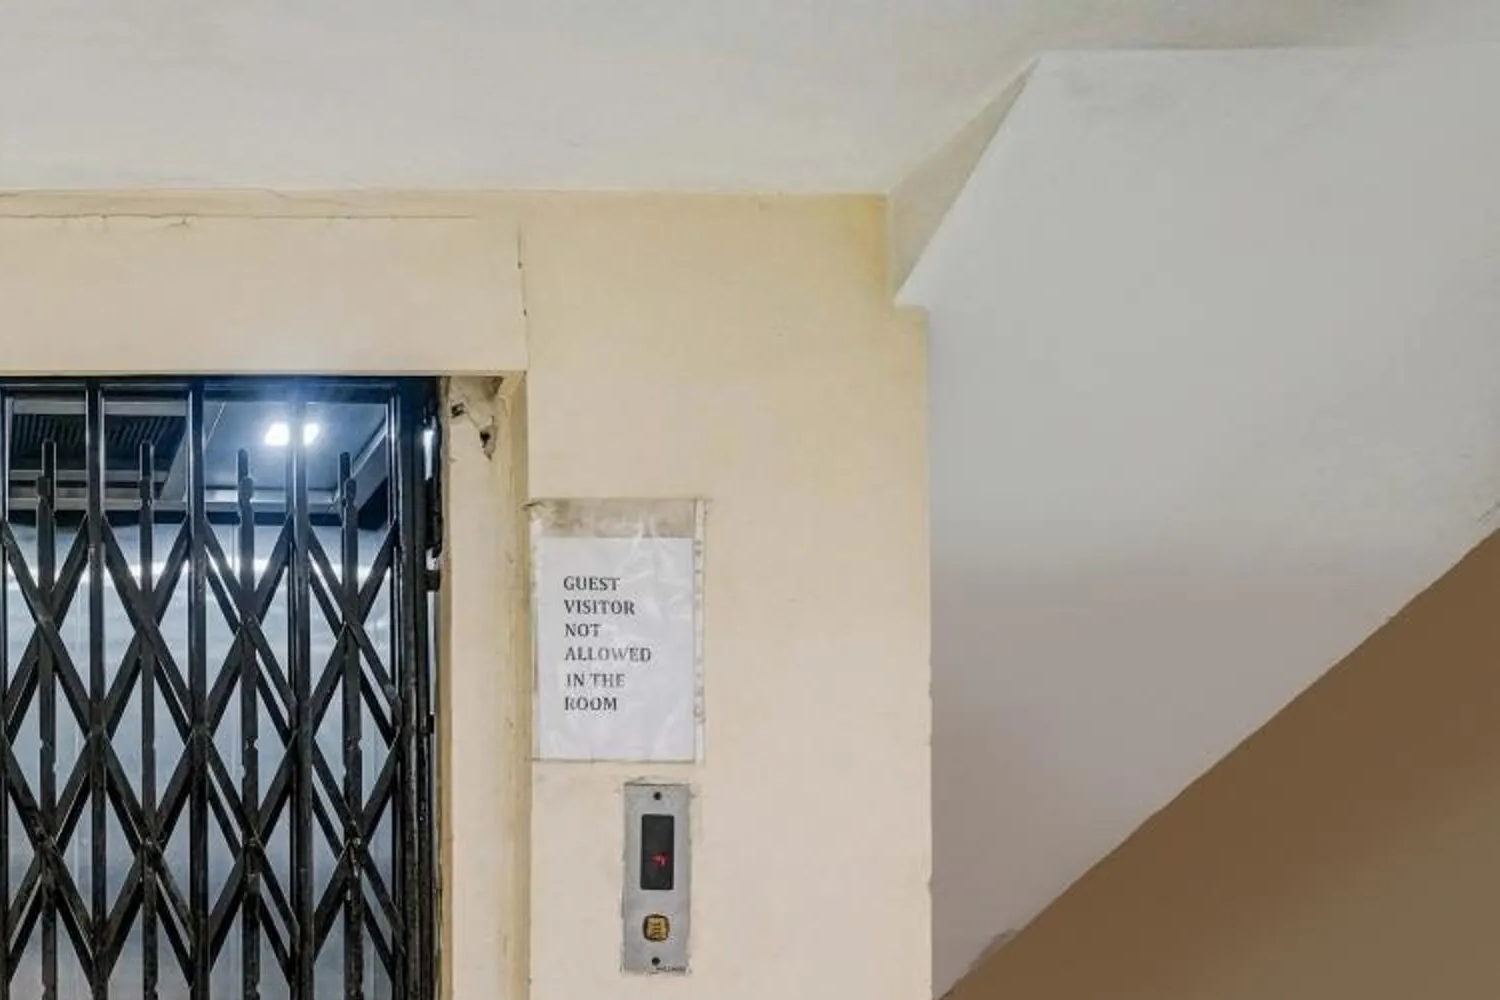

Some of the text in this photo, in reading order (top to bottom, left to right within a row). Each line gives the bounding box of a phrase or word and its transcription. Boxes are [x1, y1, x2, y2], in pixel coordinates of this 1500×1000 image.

[563, 576, 620, 591] GUEST
[564, 599, 635, 615] VISITOR
[564, 623, 602, 637] NOT
[564, 647, 652, 662] ALLOWED
[567, 673, 625, 687] IN THE
[564, 697, 617, 711] ROOM
